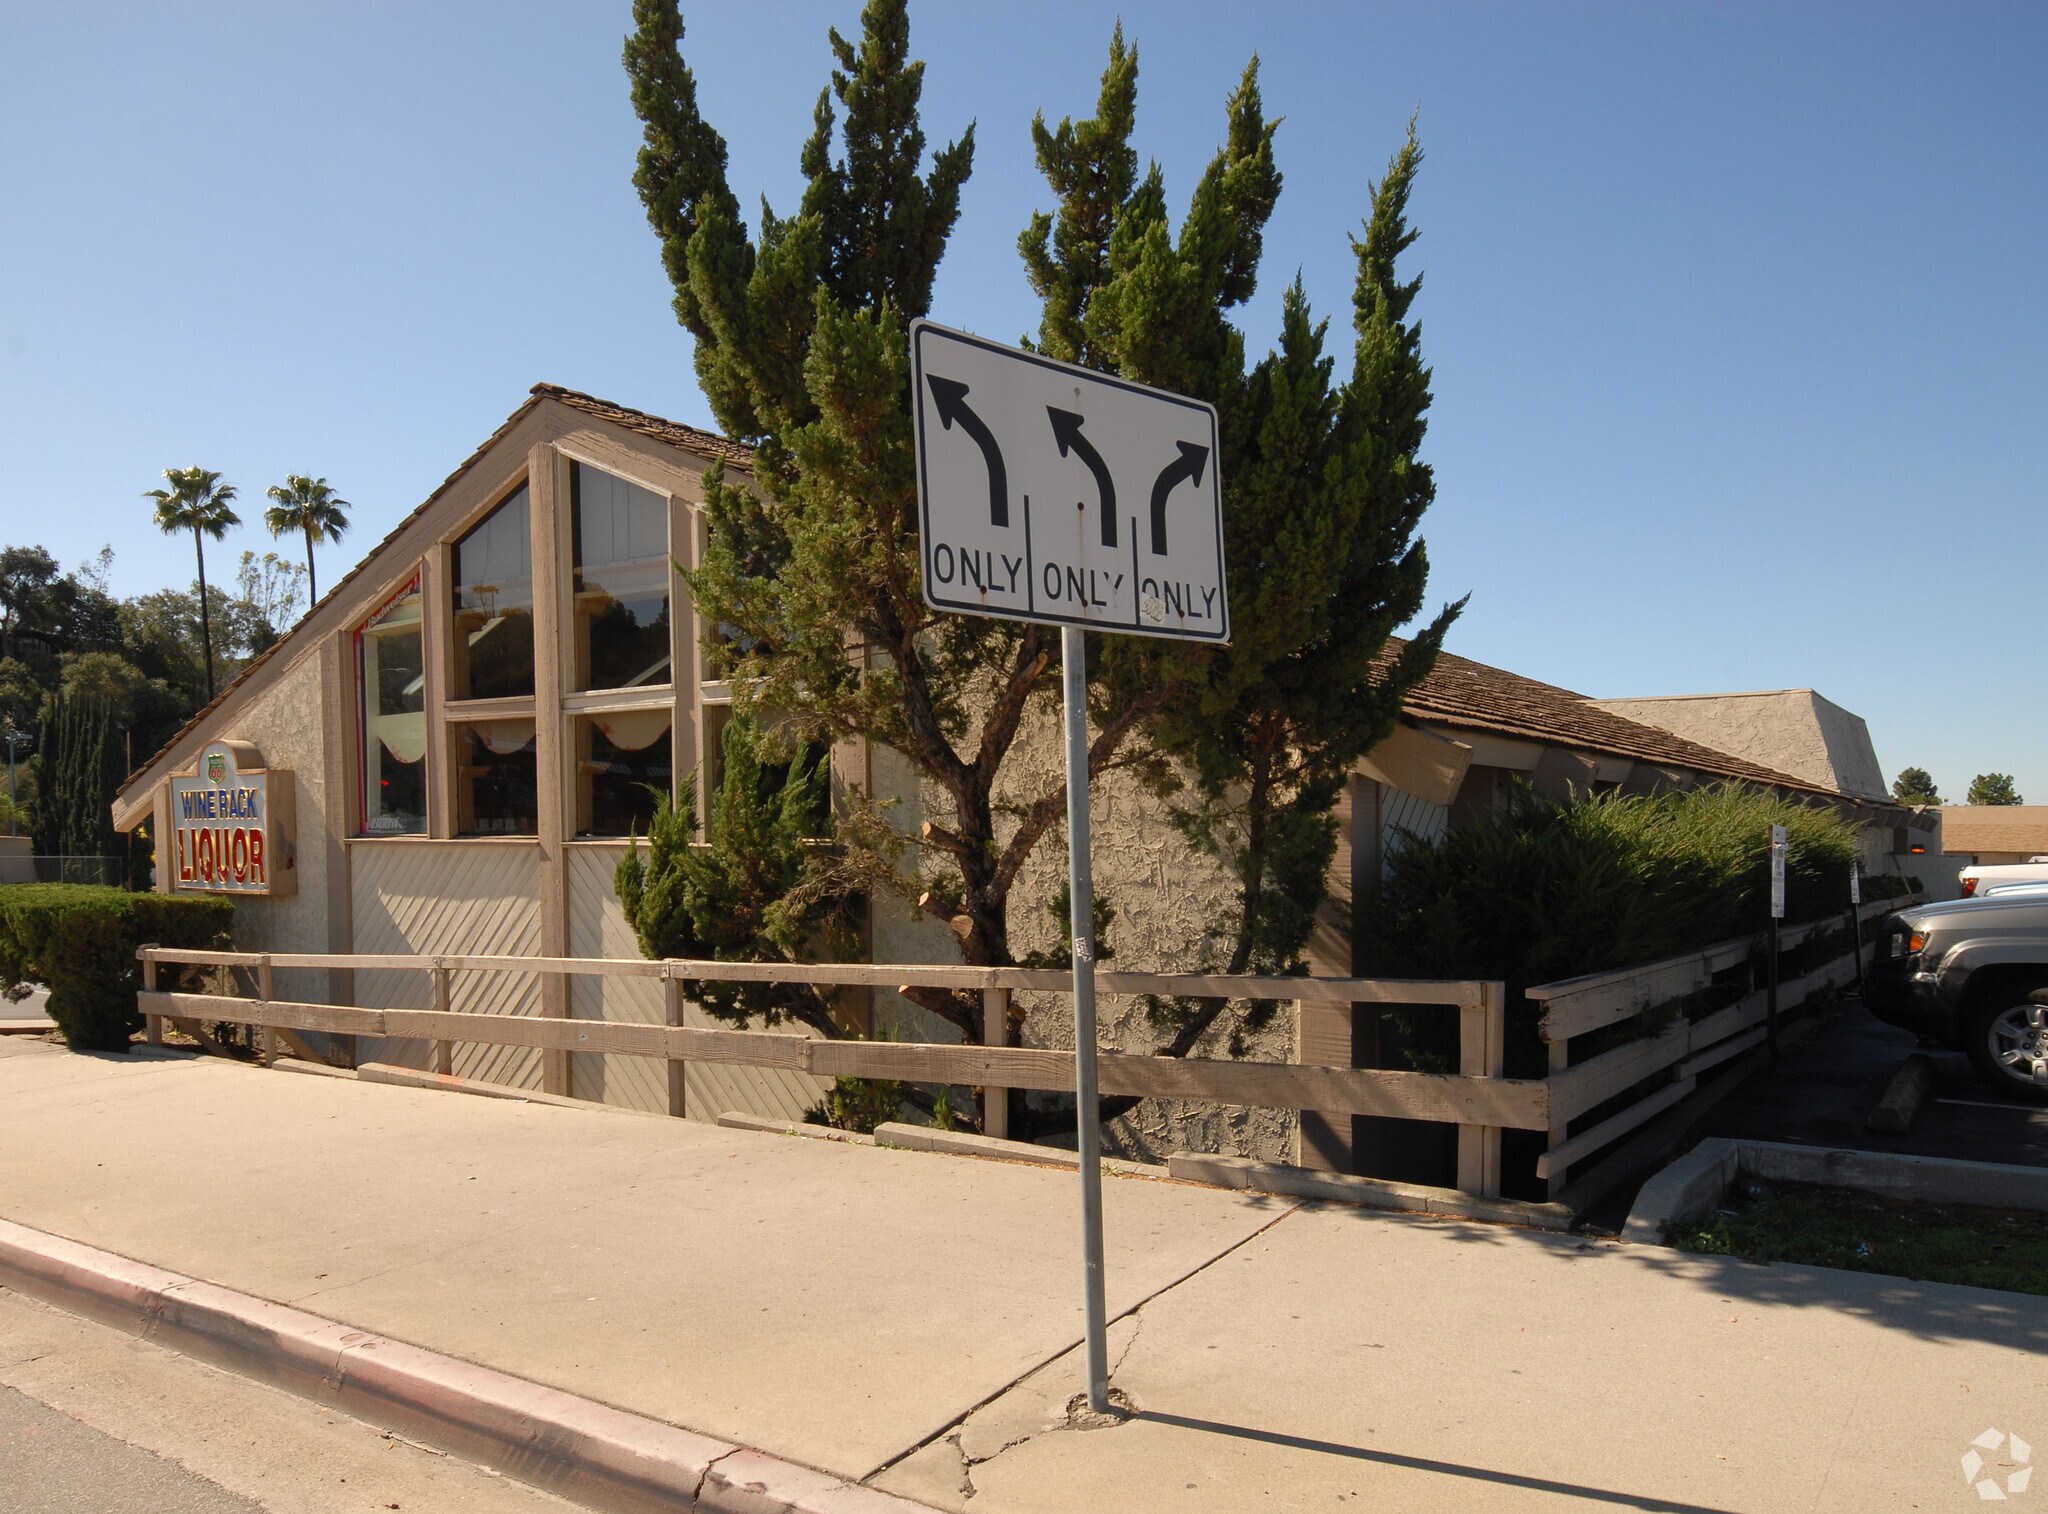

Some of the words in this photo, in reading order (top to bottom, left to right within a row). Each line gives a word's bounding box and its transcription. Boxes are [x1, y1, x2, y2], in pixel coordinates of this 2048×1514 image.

[933, 542, 1023, 594] ONLY
[1043, 561, 1124, 607] ONLY
[180, 789, 217, 820] WINE
[218, 787, 258, 820] RACK
[177, 827, 267, 885] LIQUOR
